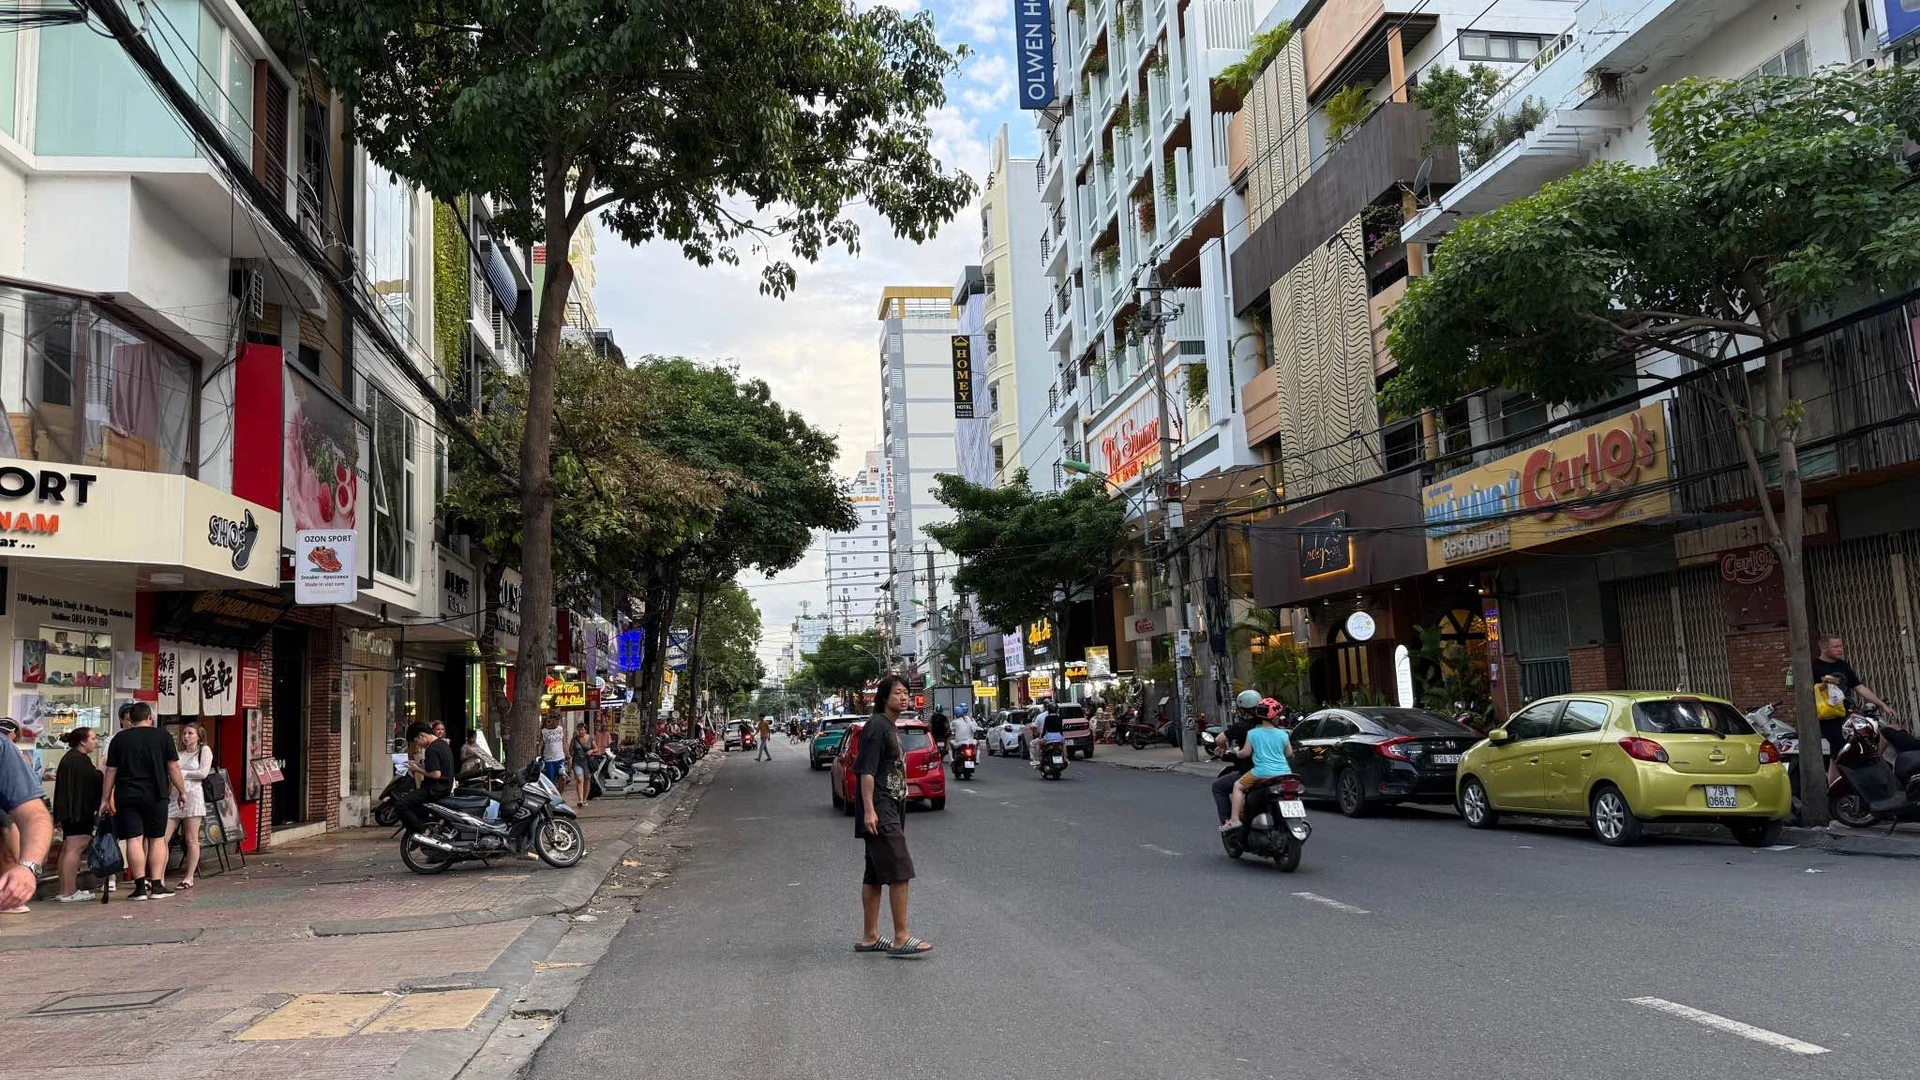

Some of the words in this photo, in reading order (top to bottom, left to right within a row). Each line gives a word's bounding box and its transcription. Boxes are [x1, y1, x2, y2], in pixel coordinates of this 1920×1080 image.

[1023, 0, 1042, 16] H
[1025, 23, 1046, 100] OLWEN
[955, 349, 970, 401] HOMEY
[0, 466, 97, 504] ORT
[1522, 412, 1655, 521] Carlo's
[885, 459, 895, 512] STARLIGHT
[208, 515, 247, 551] SHOE
[304, 535, 327, 543] OZON
[328, 534, 352, 542] SPORT
[1443, 524, 1511, 561] Restaurant
[1708, 796, 1737, 807] 068.92
[1713, 787, 1729, 796] 79A
